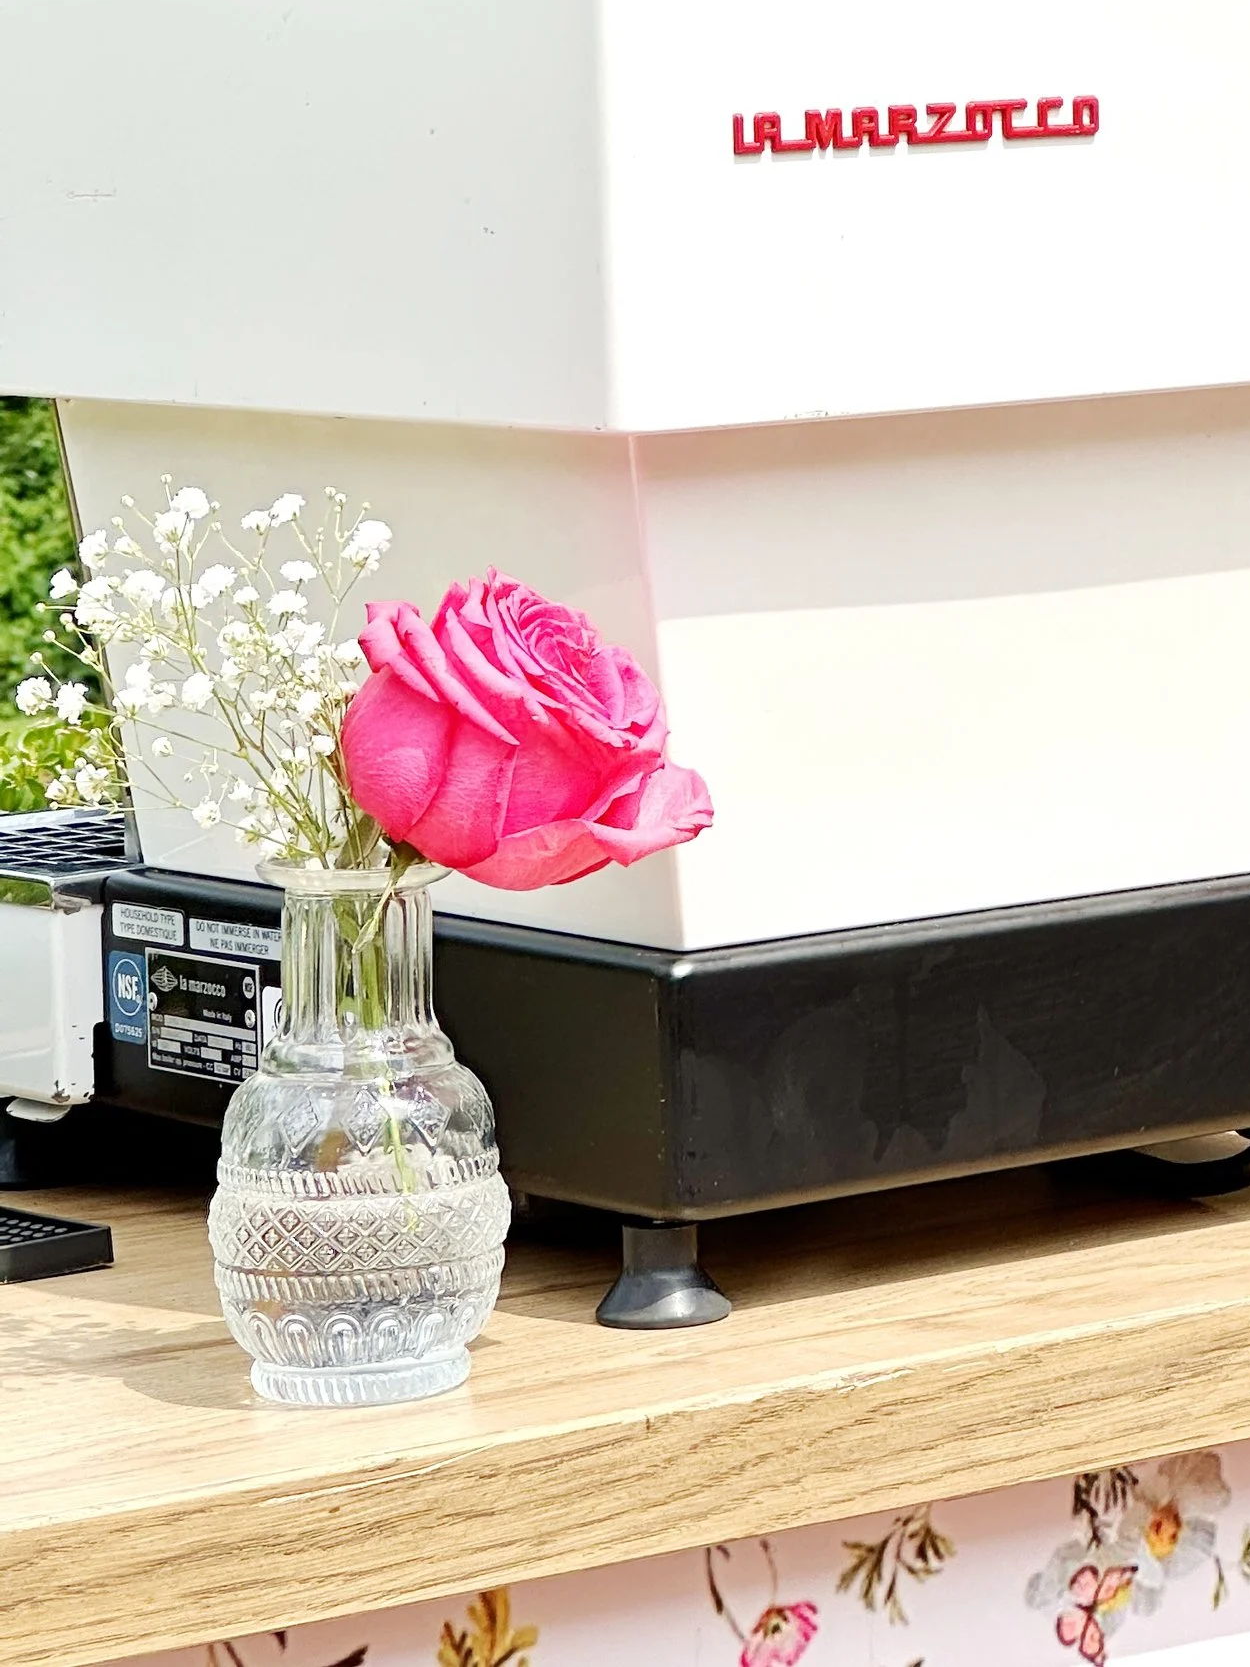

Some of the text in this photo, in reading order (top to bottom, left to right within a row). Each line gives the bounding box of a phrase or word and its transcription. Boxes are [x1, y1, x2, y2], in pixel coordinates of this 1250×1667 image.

[733, 94, 1100, 155] LA MARZOCCO
[120, 907, 176, 926] HOUSEHOLD TYPE
[120, 921, 177, 941] TYPE DOMESTIQUE
[195, 920, 205, 932] DO
[206, 922, 220, 933] NOT
[222, 925, 251, 938] IMMERSE
[252, 929, 260, 939] IN
[209, 938, 269, 955] NE PAS IMMERGER
[117, 973, 138, 1001] NSF
[179, 974, 226, 998] la marzocco
